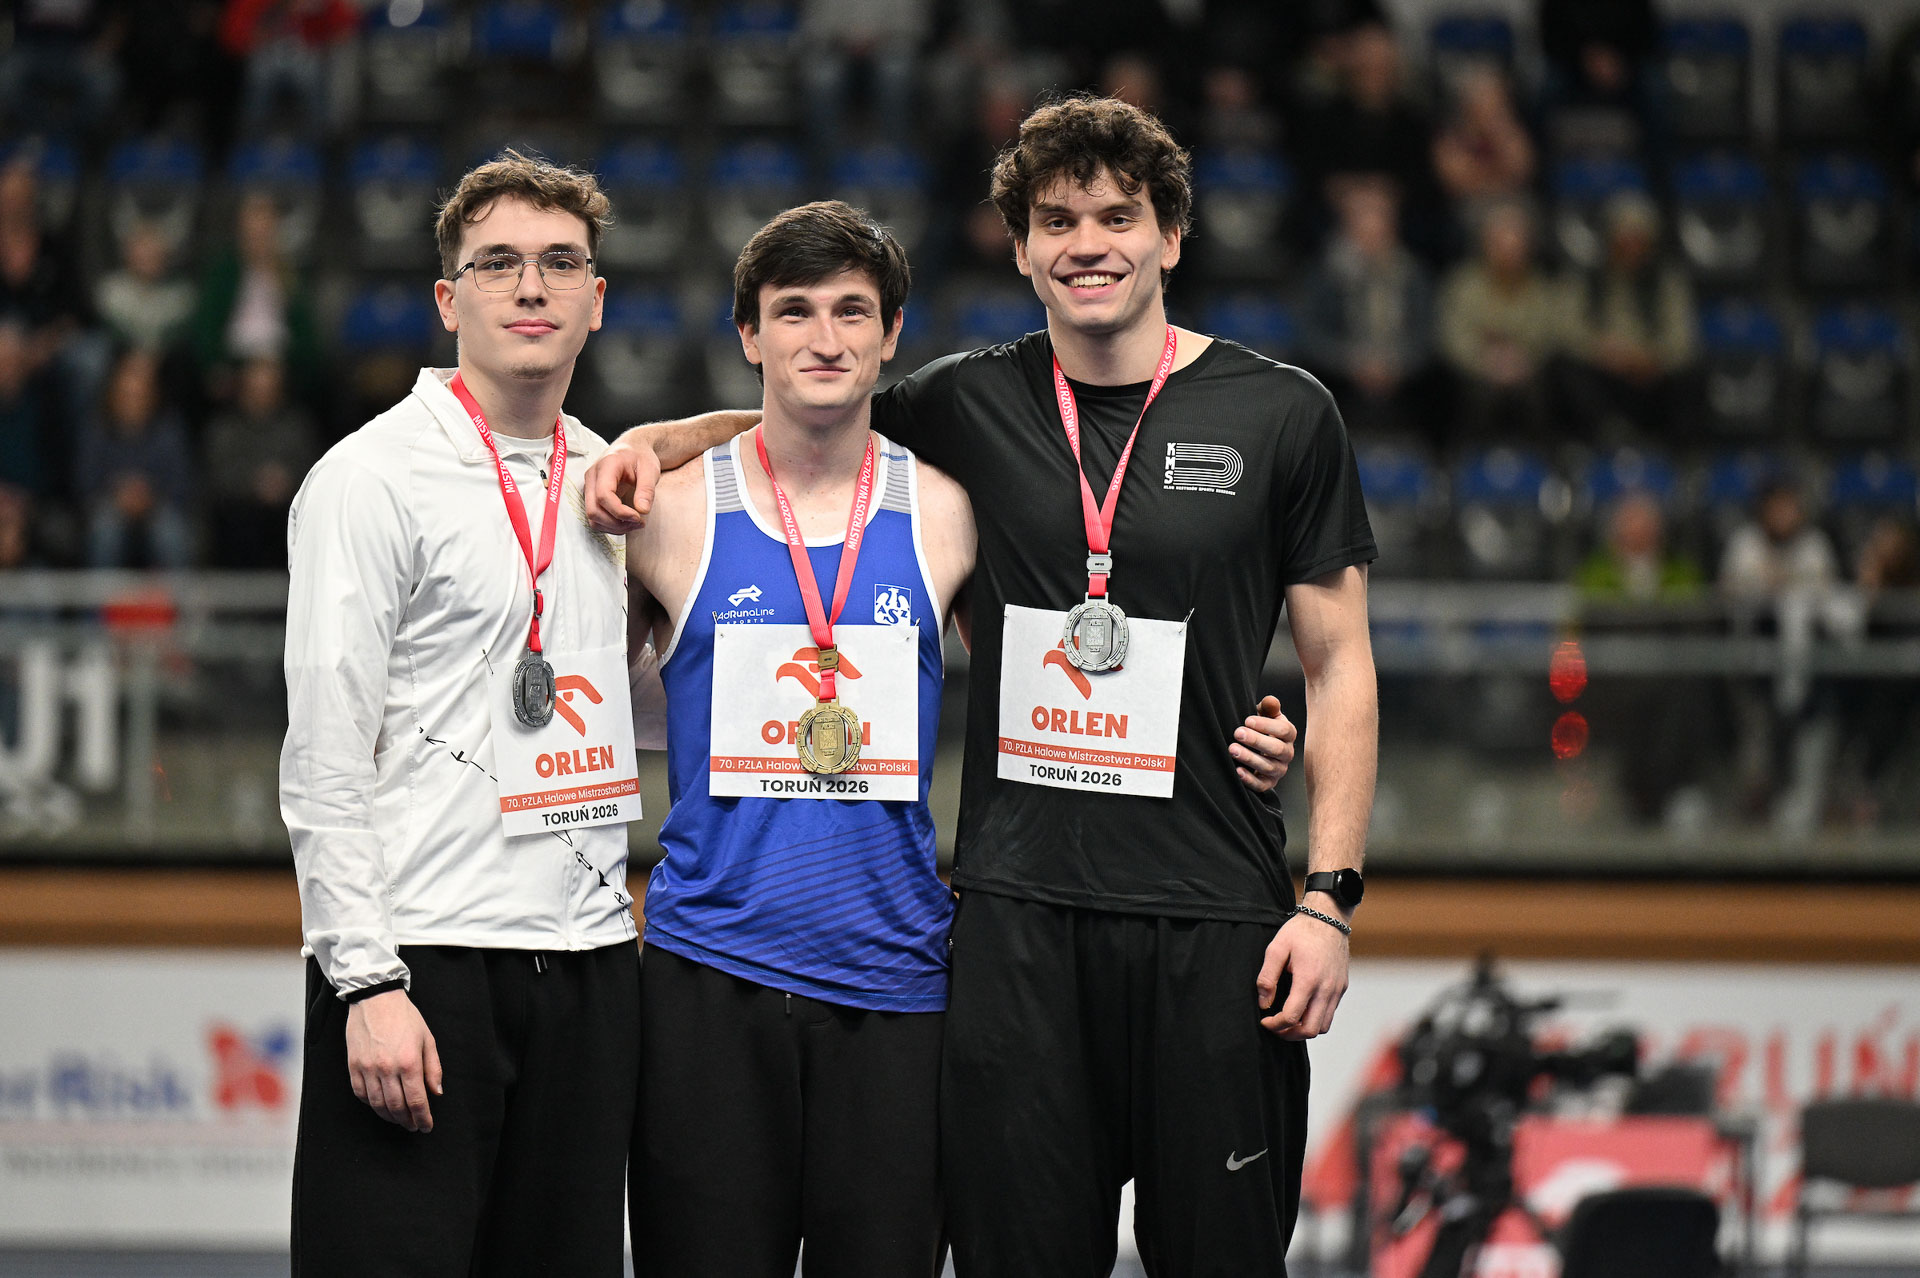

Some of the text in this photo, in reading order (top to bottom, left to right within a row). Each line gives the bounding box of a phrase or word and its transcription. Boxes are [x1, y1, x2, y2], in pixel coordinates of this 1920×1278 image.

[1159, 345, 1175, 379] POLSKI
[549, 439, 565, 503] MISTRZOSTWA
[1163, 442, 1177, 485] KMS
[1111, 467, 1123, 491] 2026
[847, 451, 873, 550] MISTRZOSTWA POLSKI
[1031, 705, 1128, 739] ORLEN
[535, 745, 615, 778] ORLEN
[719, 759, 735, 769] 70.
[738, 760, 763, 770] PZLA
[880, 762, 910, 772] Polski
[1003, 741, 1167, 768] 70. PZLA Halowe Mistrzostwa Polski
[760, 777, 869, 793] TORUŃ 2026
[1029, 764, 1122, 786] TORUŃ 2026
[507, 781, 636, 809] 70. PZLA Halowe Mistrzostwa Polski
[542, 803, 619, 826] TORUŃ 2026
